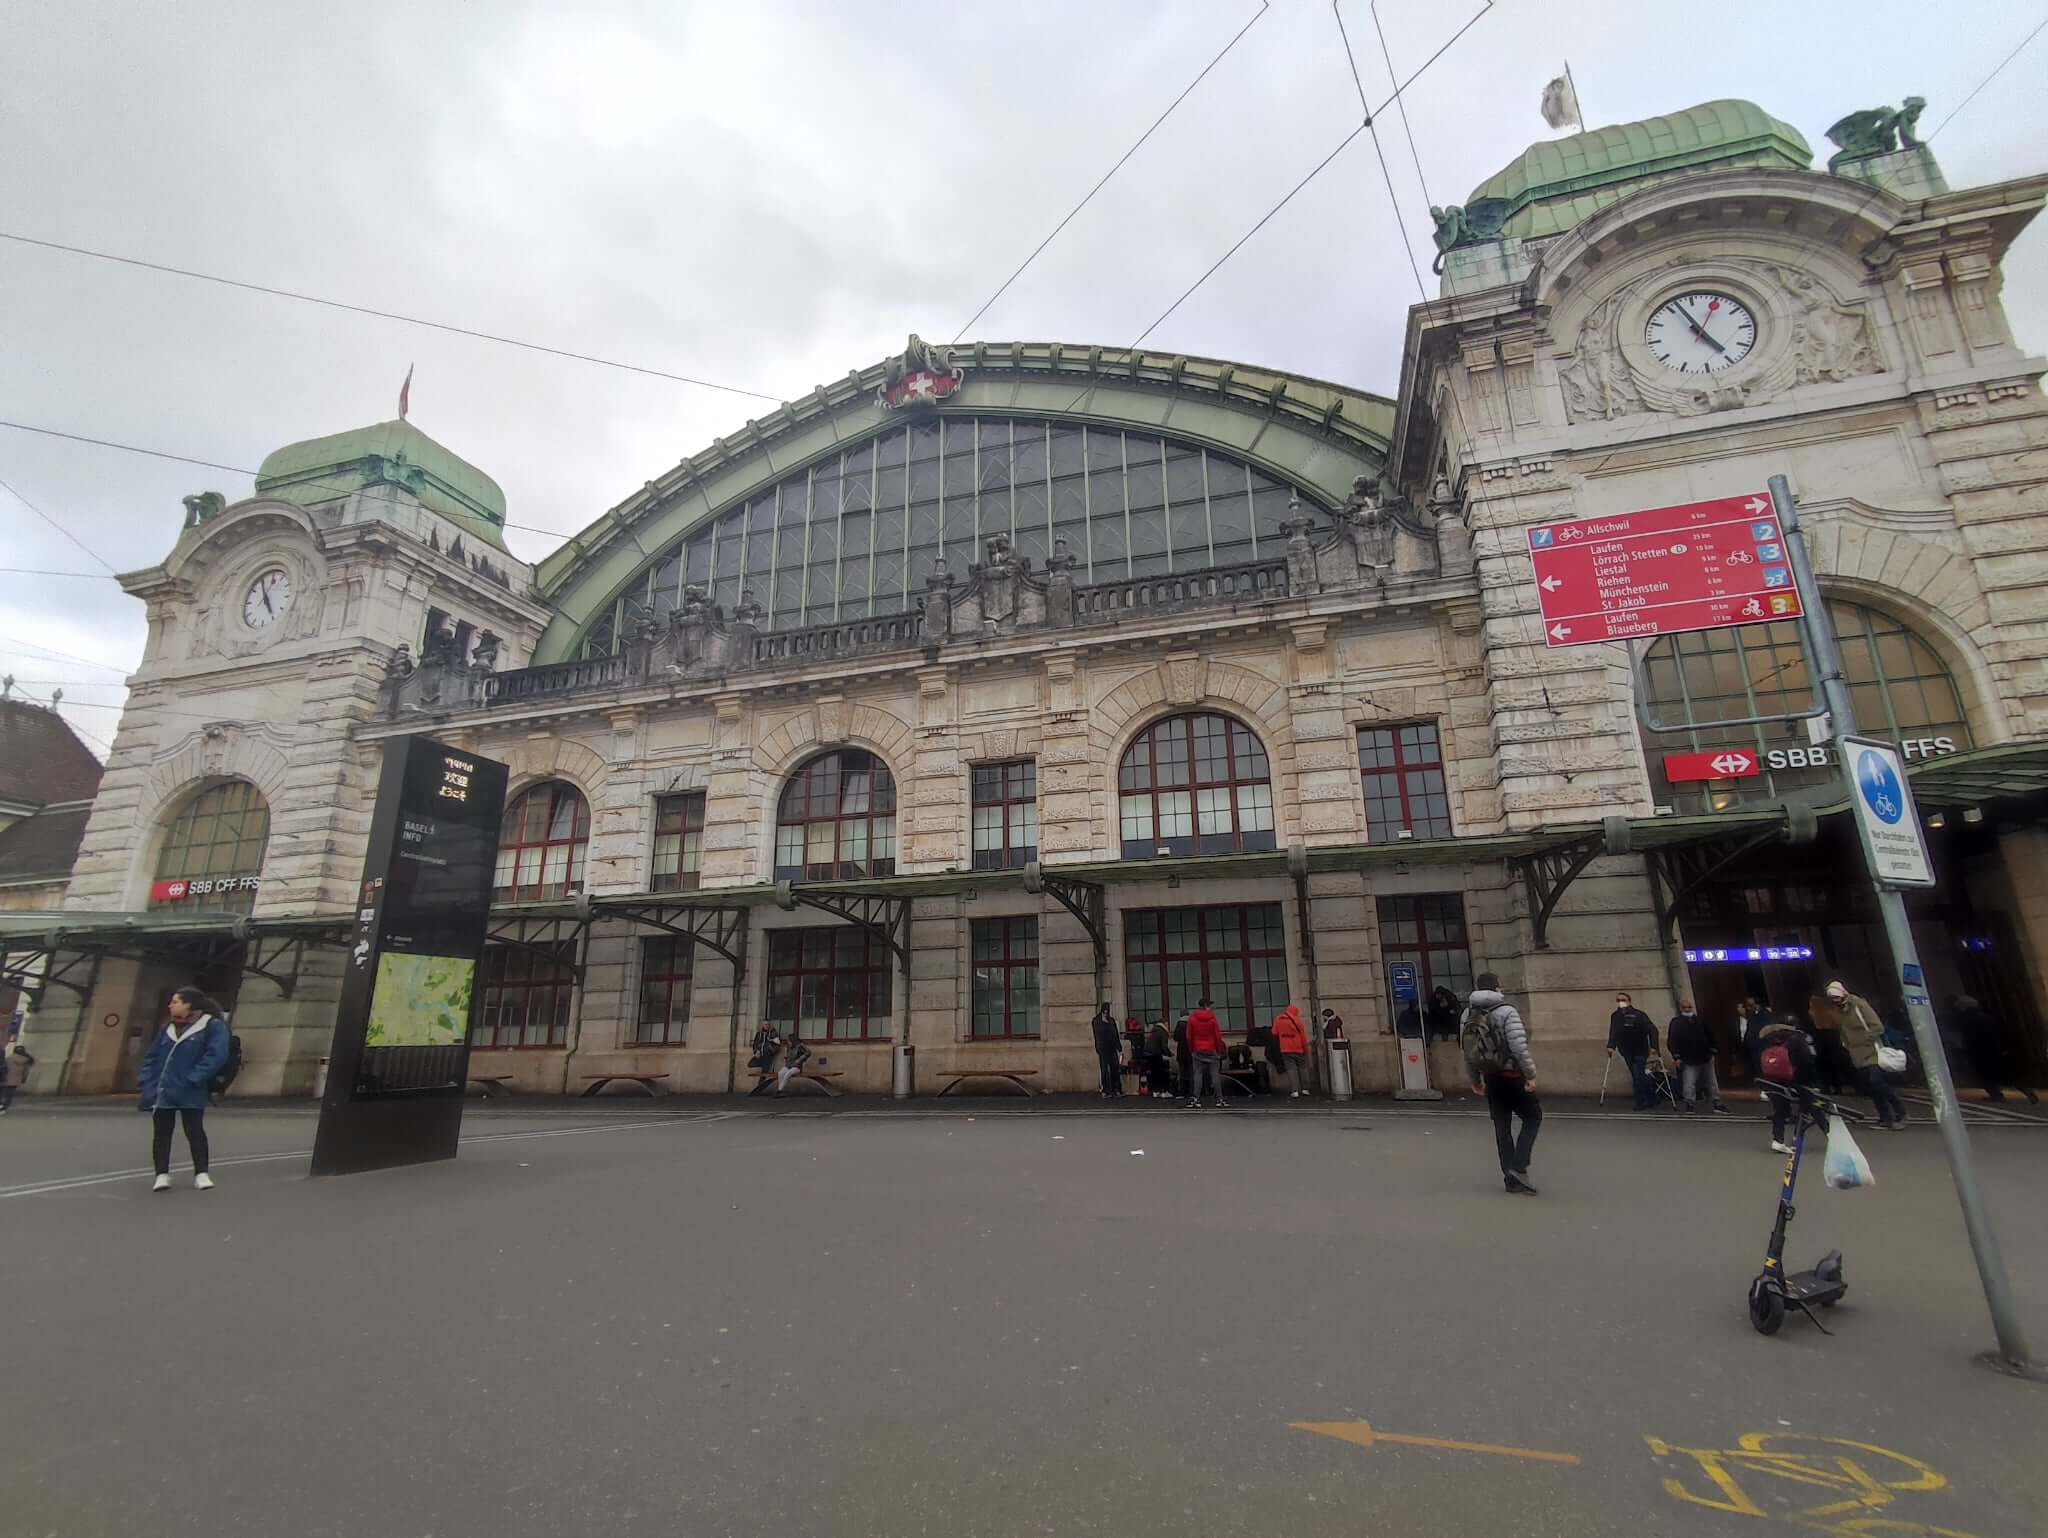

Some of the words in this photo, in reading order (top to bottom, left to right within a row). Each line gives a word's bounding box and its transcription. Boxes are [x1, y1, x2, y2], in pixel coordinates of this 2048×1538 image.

[1587, 520, 1630, 536] Allschwil
[1760, 525, 1774, 540] 2
[1537, 528, 1549, 544] 7
[1590, 543, 1624, 555] Laufen
[1632, 548, 1668, 561] Stetten
[1766, 543, 1780, 559] 3
[1595, 564, 1627, 577] Liestal
[1597, 576, 1631, 588] Riehen
[1766, 574, 1784, 587] 23
[1600, 582, 1669, 599] Münchenstein
[1602, 600, 1614, 611] St.
[1618, 597, 1646, 609] Jakob
[1773, 598, 1787, 615] 3
[1605, 612, 1639, 625] Laufen
[1607, 621, 1658, 636] Blaueberg
[1767, 746, 1828, 769] SBB
[1902, 736, 1956, 759] FFS
[404, 821, 429, 834] BASEL
[402, 831, 422, 842] INFO
[188, 880, 213, 895] SBB
[216, 878, 237, 892] CFF
[239, 876, 261, 890] FFS
